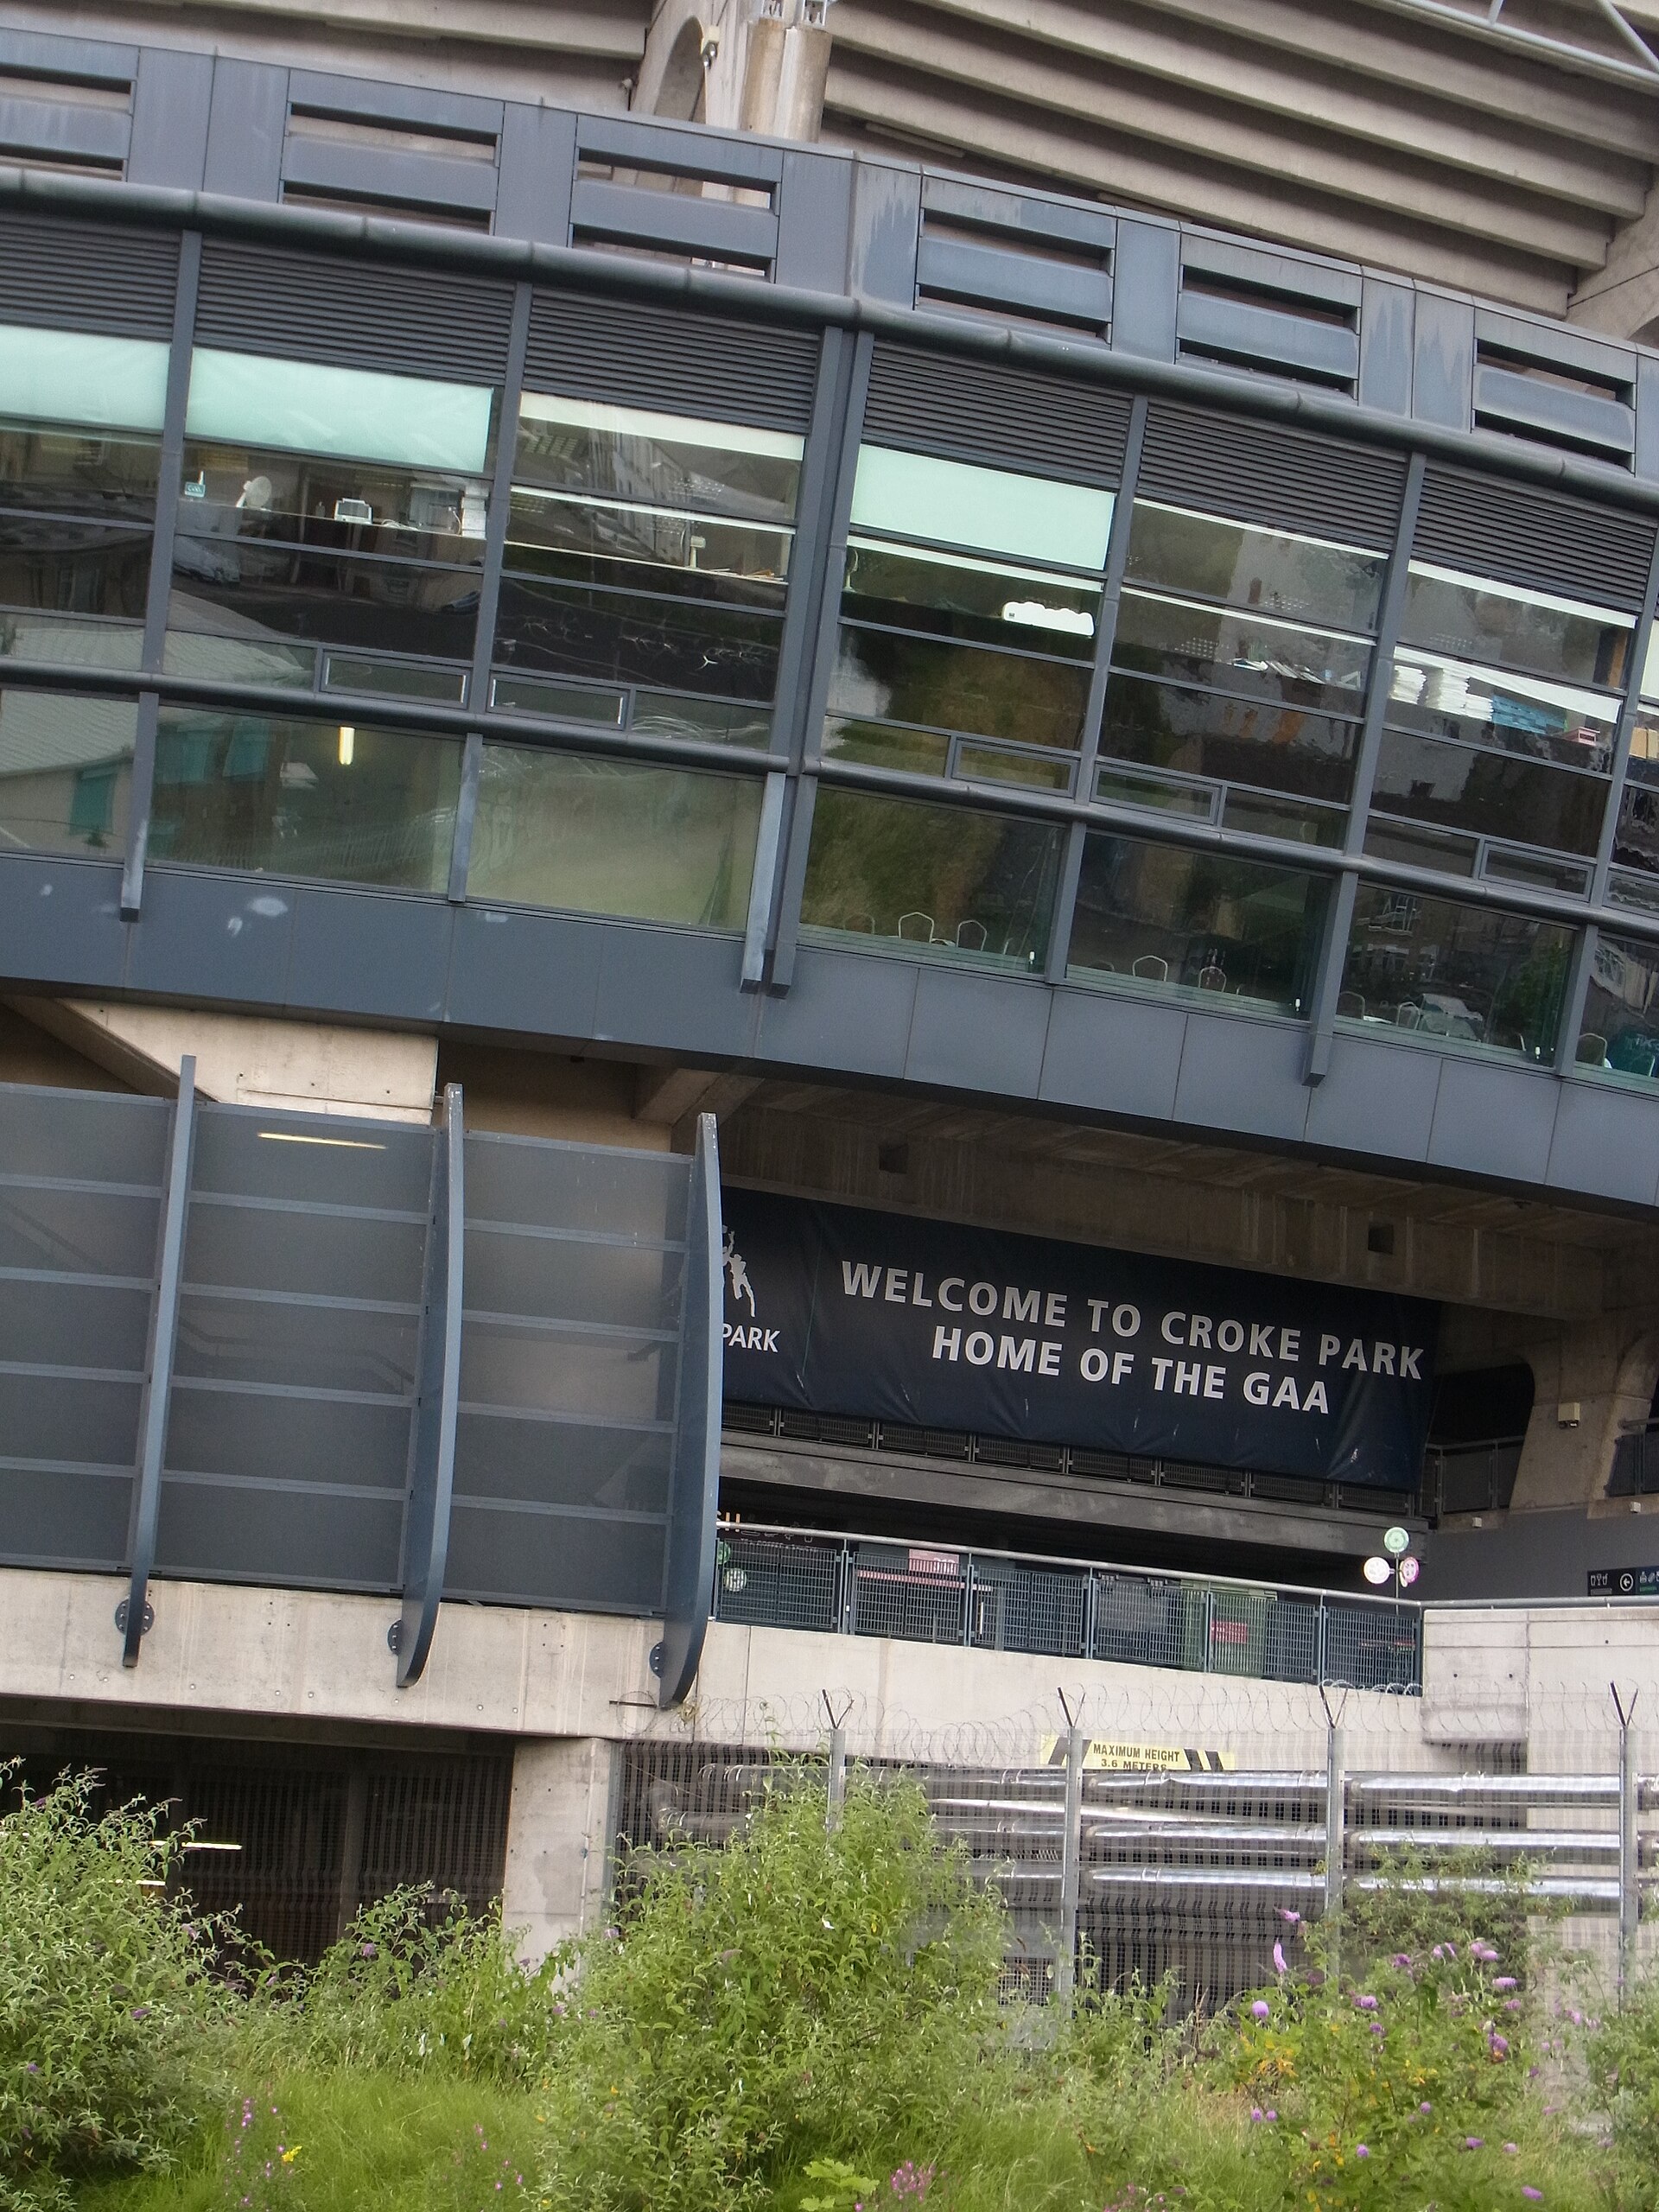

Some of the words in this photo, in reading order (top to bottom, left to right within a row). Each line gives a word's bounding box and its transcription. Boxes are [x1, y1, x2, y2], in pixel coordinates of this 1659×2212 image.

[842, 1261, 1068, 1327] WELCOME
[1086, 1298, 1141, 1338] TO
[1160, 1311, 1301, 1362] CROKE
[1319, 1334, 1424, 1380] PARK
[723, 1323, 780, 1353] PARK
[932, 1325, 1063, 1376] HOME
[1079, 1348, 1135, 1385] OF
[1151, 1357, 1227, 1400] THE
[1243, 1372, 1329, 1414] GAA
[1093, 1743, 1141, 1758] MAXIMUM
[1145, 1748, 1180, 1763] HEIGHT
[1101, 1758, 1118, 1768] 3.6
[1122, 1760, 1167, 1771] METERS
